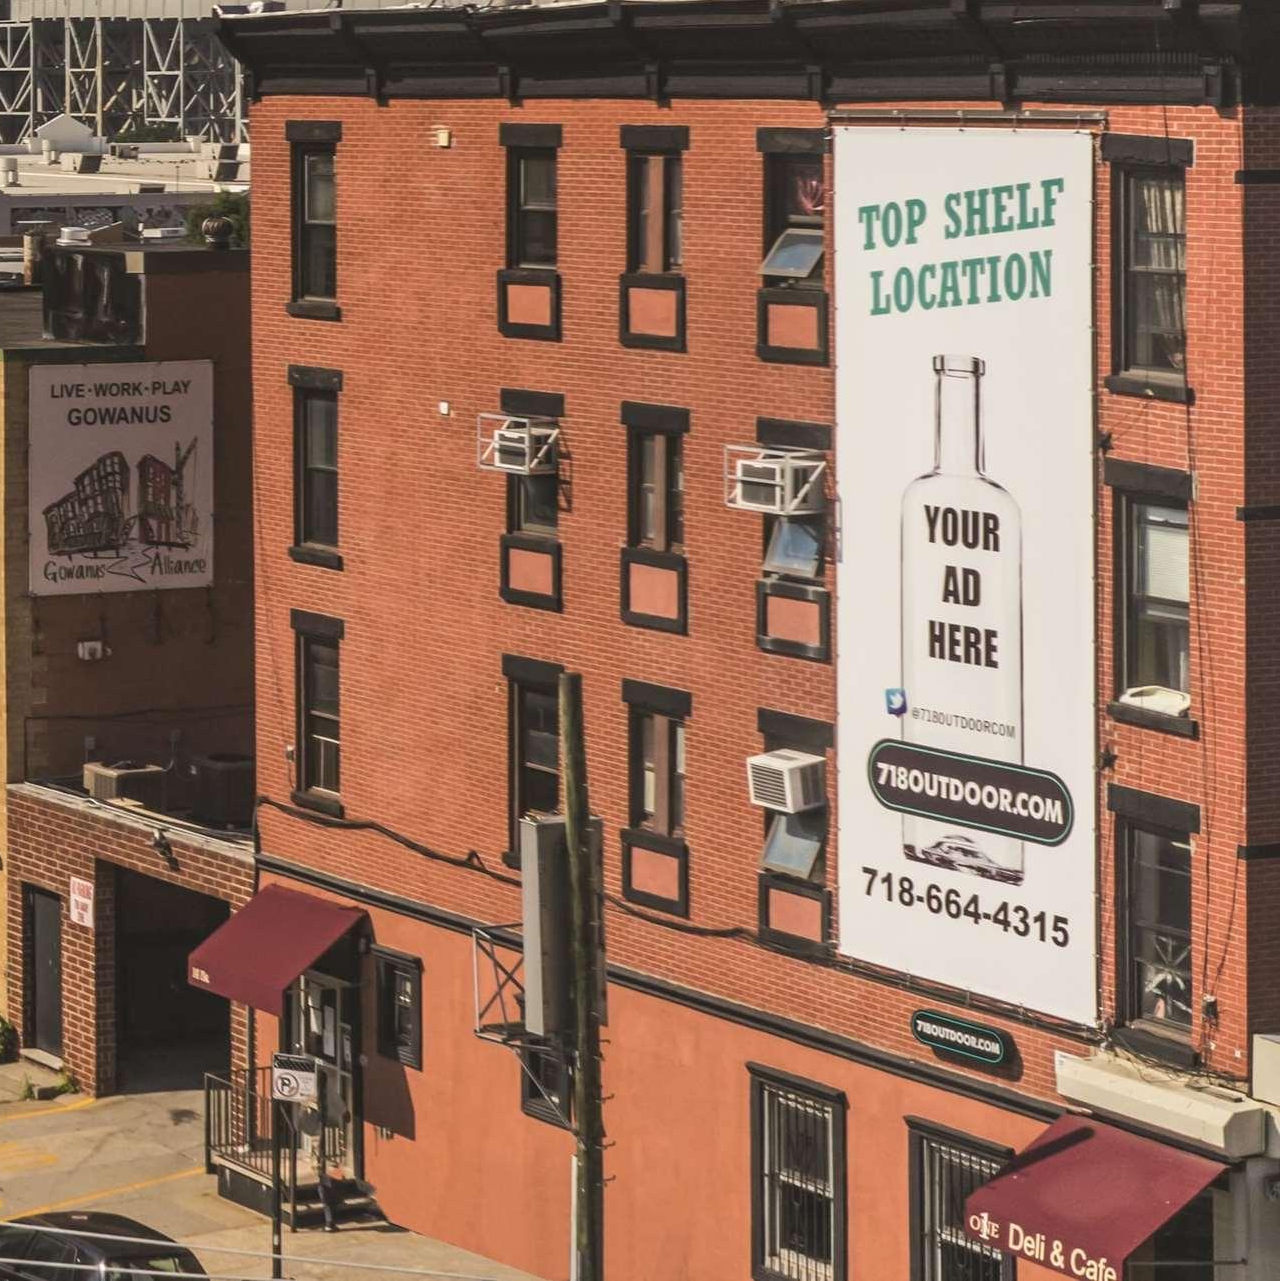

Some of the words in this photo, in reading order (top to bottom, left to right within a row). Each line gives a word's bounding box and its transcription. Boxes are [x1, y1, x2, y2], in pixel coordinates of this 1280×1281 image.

[858, 198, 927, 251] TOP
[944, 177, 1065, 240] SHELF
[870, 249, 1053, 316] LOCATION
[67, 405, 172, 426] GOWANUS
[923, 504, 1000, 552] YOUR
[43, 561, 105, 583] Gowanus
[151, 552, 207, 577] Alliance
[942, 565, 981, 607] AD
[928, 619, 999, 669] HERE
[876, 761, 1064, 825] 718OUTDOOR.COM
[862, 866, 1070, 948] 718-664-4315
[916, 1020, 1000, 1055] 718OUTDOOR.COM
[1008, 1222, 1046, 1261] Deli
[1050, 1240, 1065, 1269] &
[1070, 1248, 1117, 1281] Cafe
